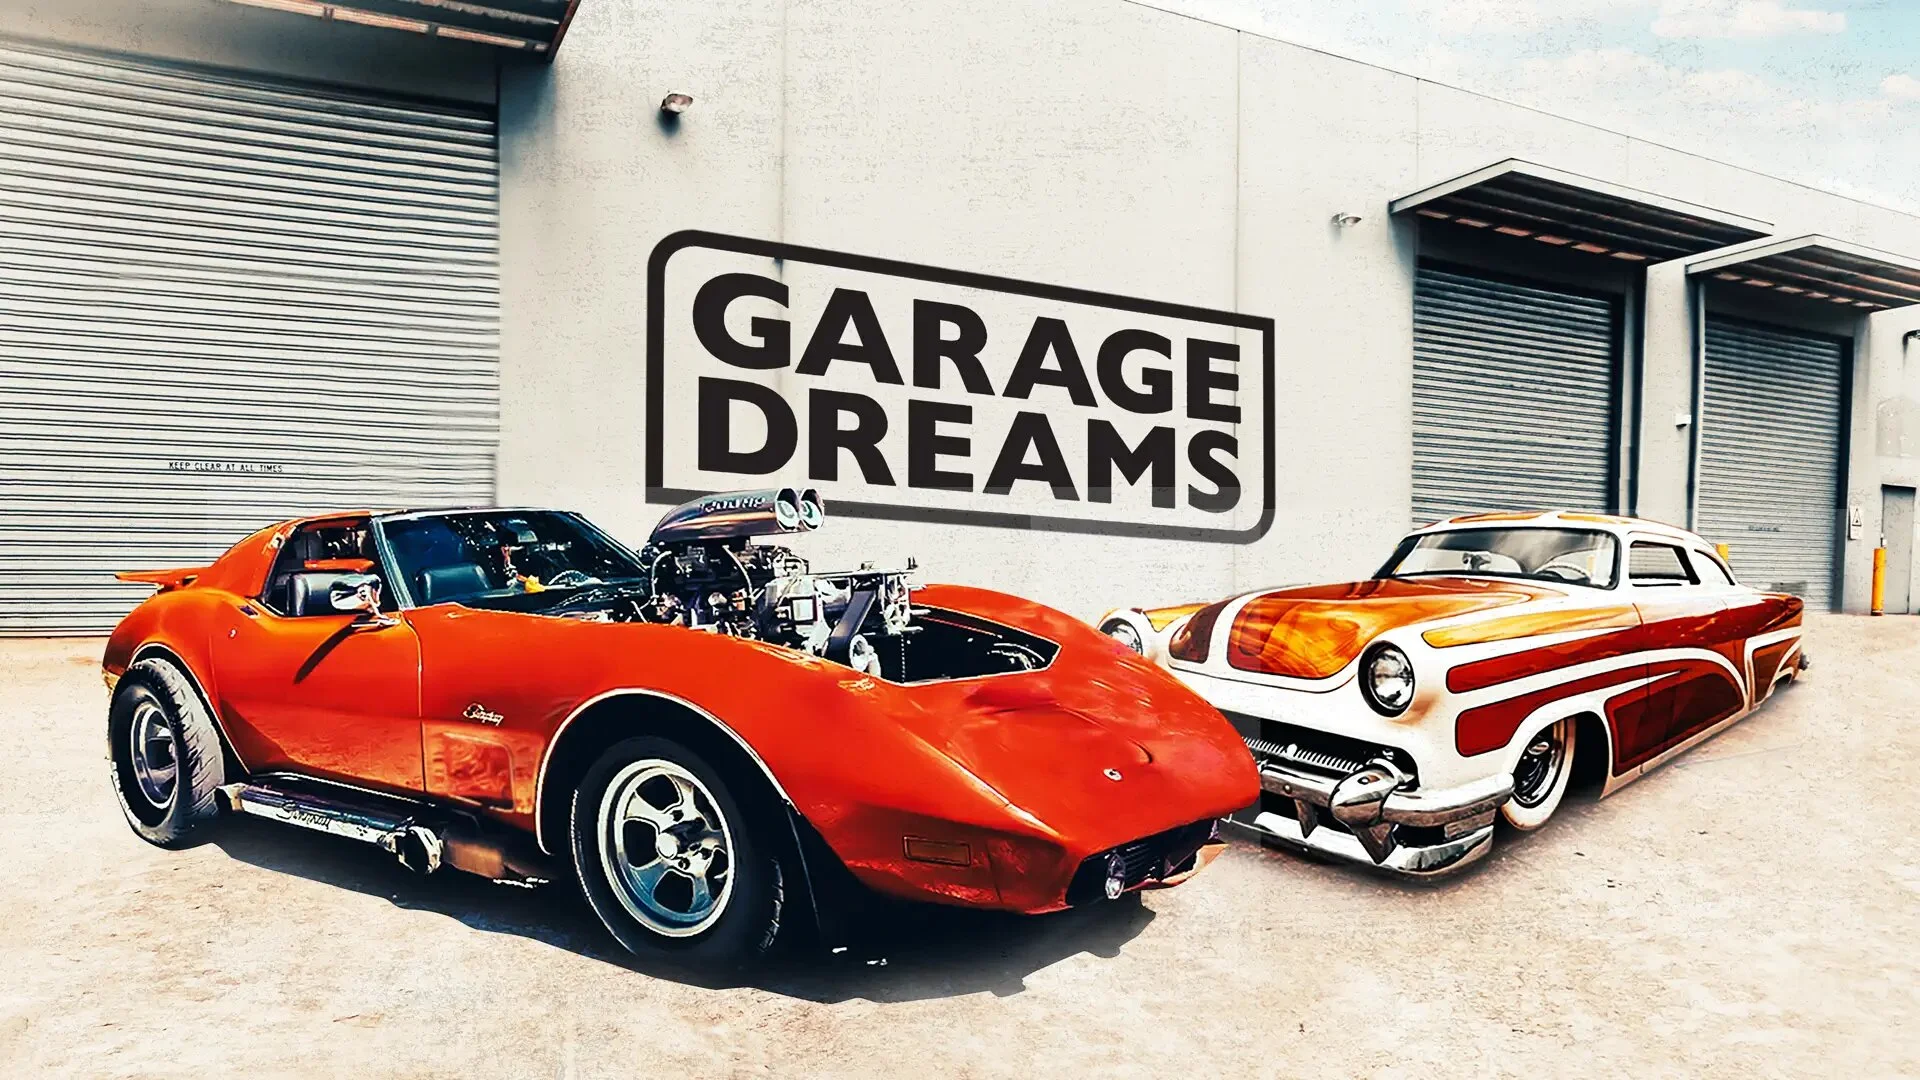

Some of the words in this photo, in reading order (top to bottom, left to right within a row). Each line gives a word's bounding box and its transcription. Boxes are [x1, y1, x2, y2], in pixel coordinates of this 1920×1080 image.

[692, 273, 1242, 424] GARAGE
[168, 461, 190, 470] KEEP
[195, 462, 221, 471] CLEAR
[226, 463, 235, 471] AT
[240, 464, 255, 472] ALL
[260, 464, 283, 473] TIMES
[698, 376, 1242, 513] DREAMS
